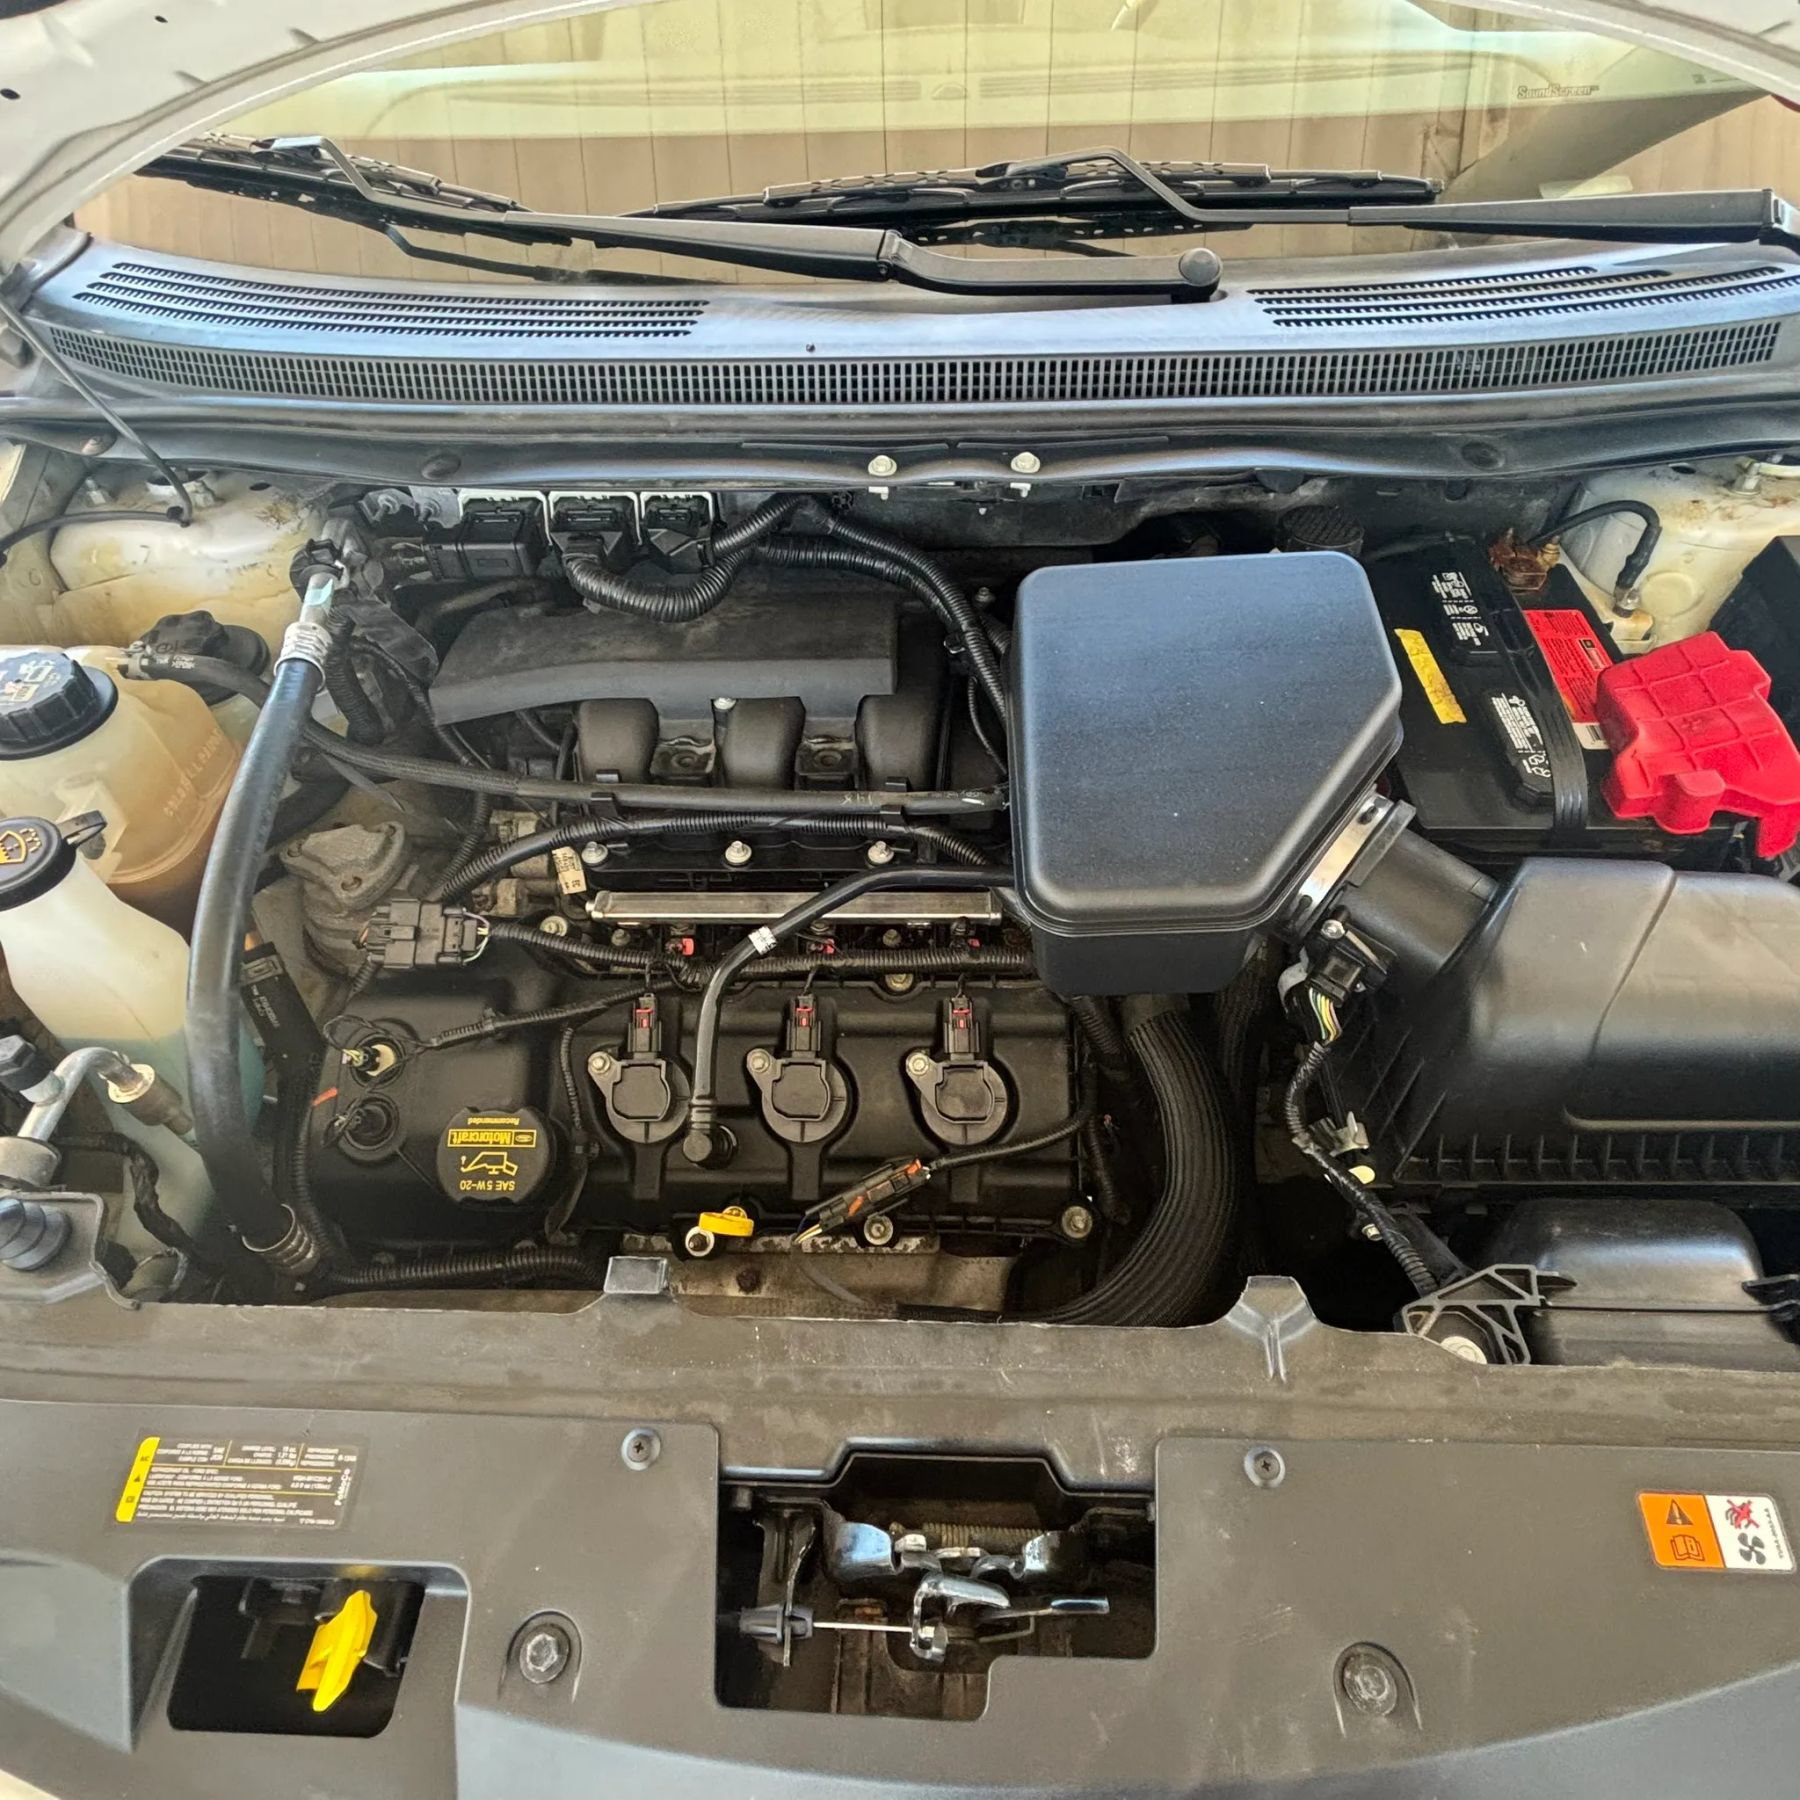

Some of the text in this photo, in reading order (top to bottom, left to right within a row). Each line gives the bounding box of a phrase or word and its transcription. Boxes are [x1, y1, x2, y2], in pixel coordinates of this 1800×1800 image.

[467, 1117, 520, 1126] Recommended
[452, 1131, 511, 1145] Motorcraft
[495, 1180, 516, 1191] SAE
